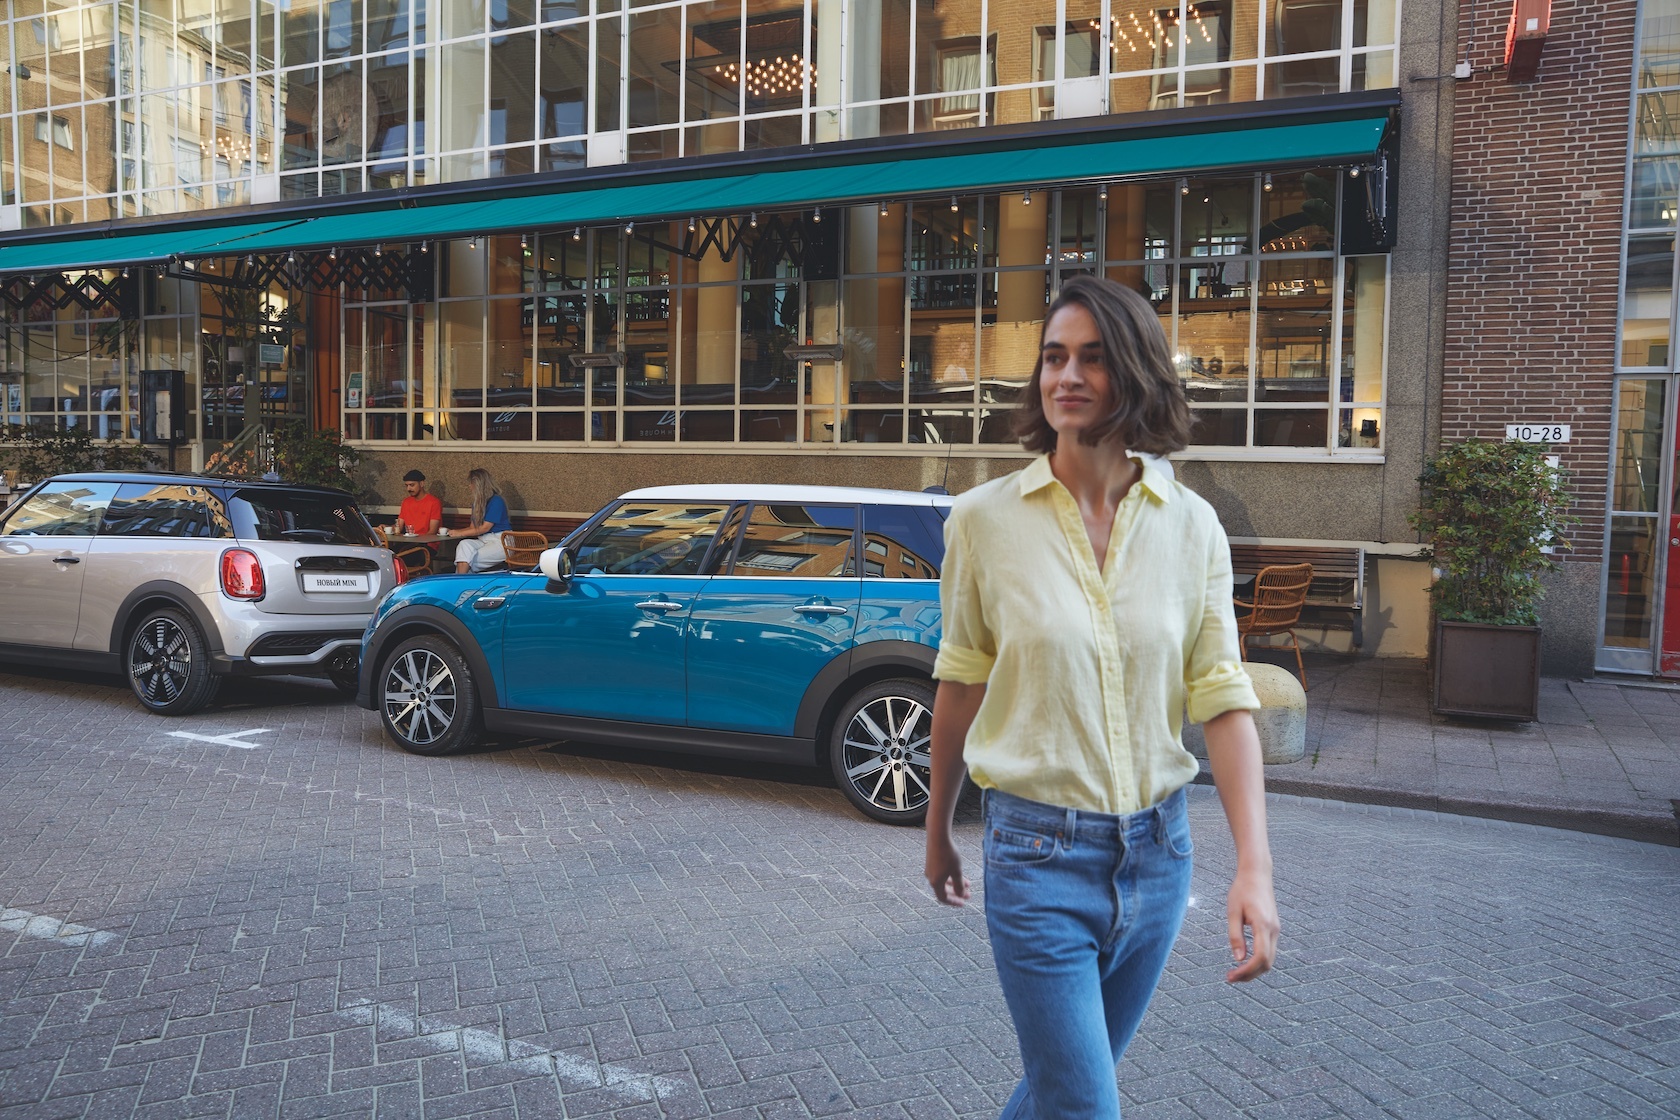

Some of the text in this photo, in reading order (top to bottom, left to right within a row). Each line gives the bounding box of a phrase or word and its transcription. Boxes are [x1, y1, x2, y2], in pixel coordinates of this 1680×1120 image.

[1515, 427, 1562, 441] 10-28
[316, 578, 357, 587] НОВЫЙ MINI
